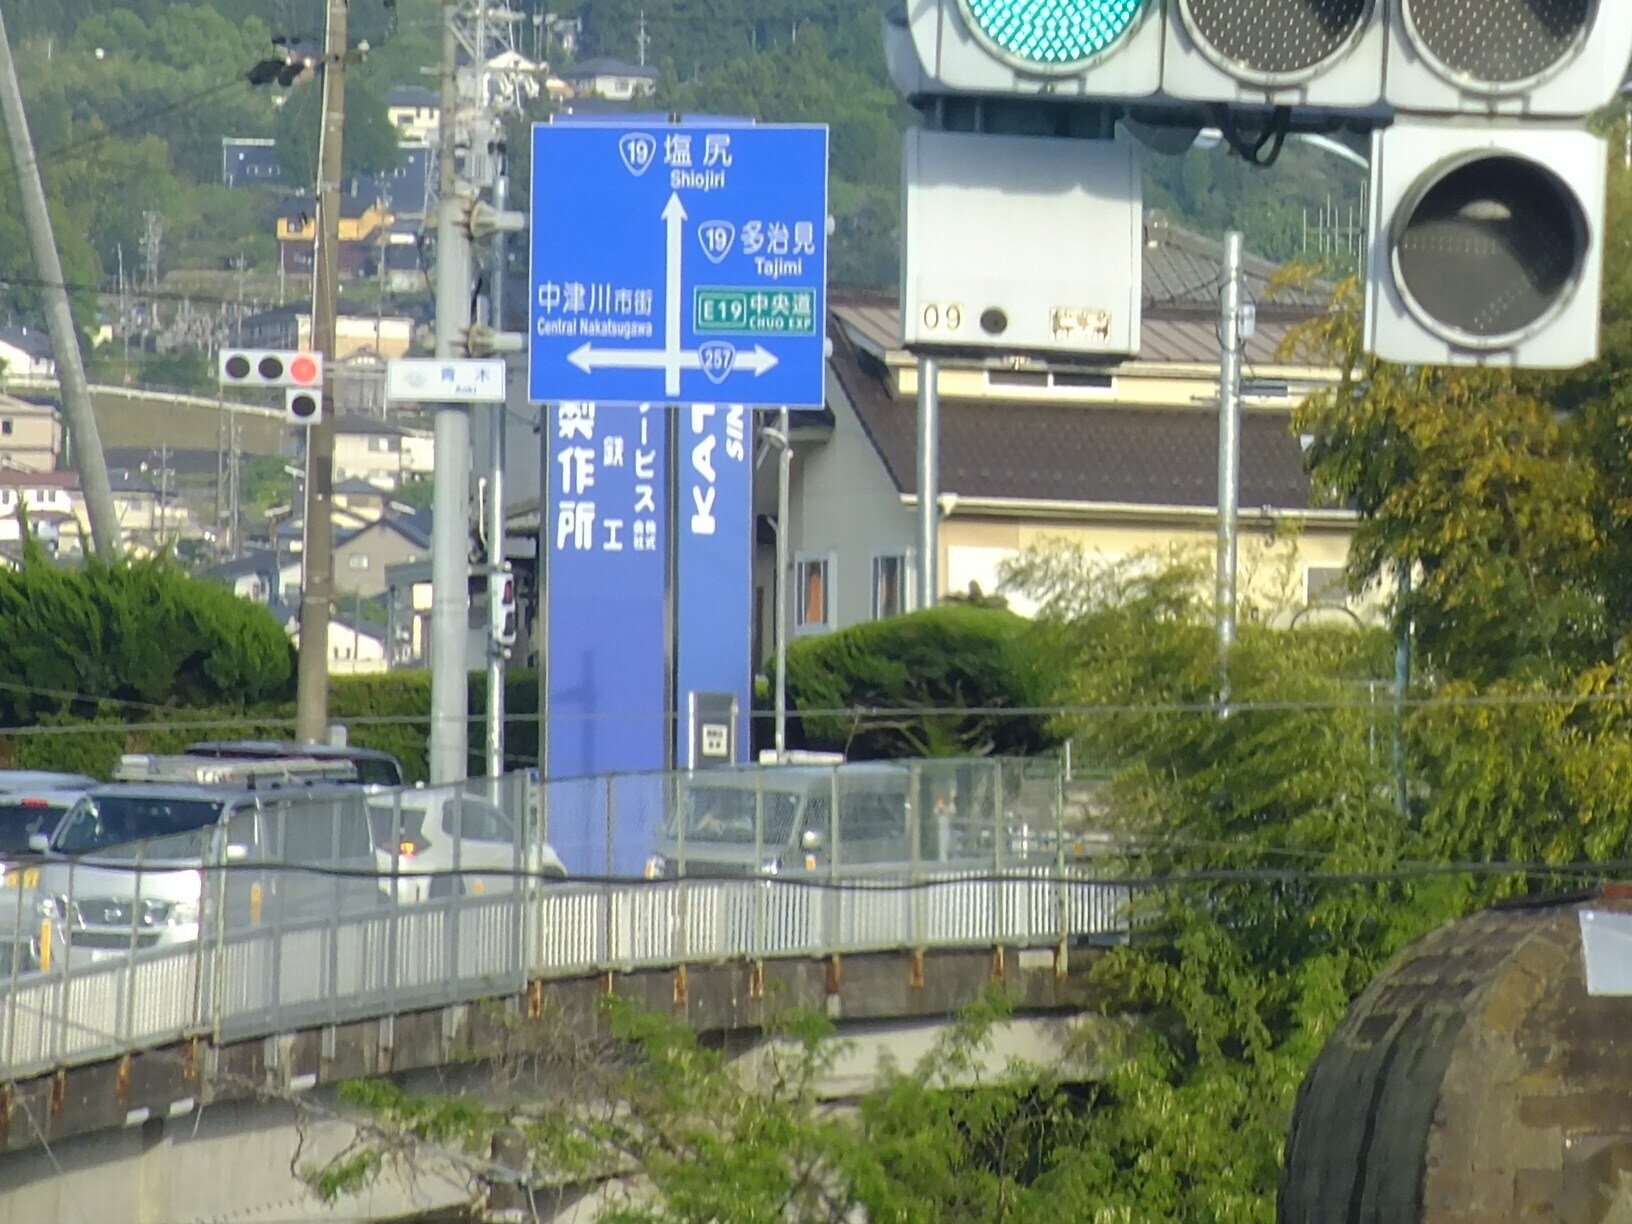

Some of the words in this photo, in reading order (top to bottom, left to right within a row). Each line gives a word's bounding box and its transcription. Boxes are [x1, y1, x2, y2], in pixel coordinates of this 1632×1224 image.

[627, 140, 649, 164] 19
[664, 133, 733, 167] 塩尻
[670, 169, 725, 192] Shiojiri
[706, 227, 727, 252] 19
[741, 220, 815, 255] 多治見
[754, 256, 802, 280] Tajimi
[538, 279, 653, 317] 中津川市街
[750, 293, 811, 317] 中央道
[537, 316, 577, 337] Central
[579, 317, 653, 340] Nakatsugawa
[749, 316, 784, 330] CHUO
